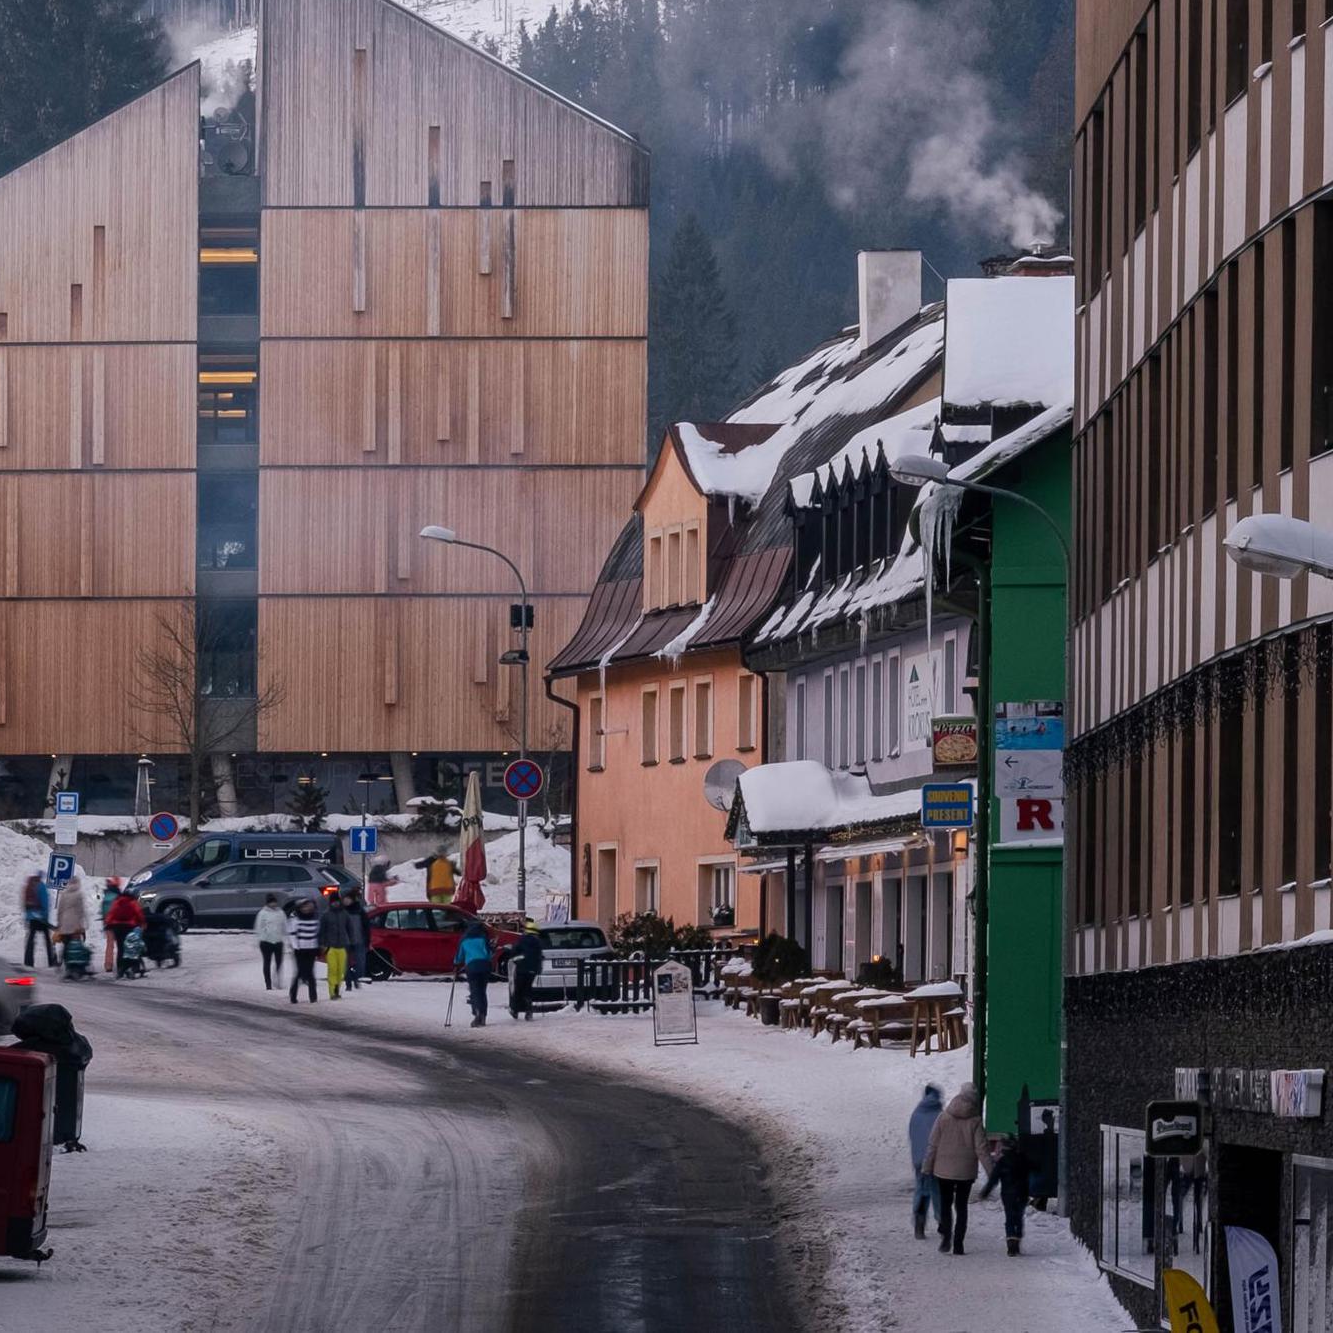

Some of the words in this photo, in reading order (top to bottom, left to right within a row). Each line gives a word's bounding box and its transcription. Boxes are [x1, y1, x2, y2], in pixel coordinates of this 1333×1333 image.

[939, 722, 973, 734] Pizza
[1016, 798, 1055, 831] R
[53, 857, 69, 878] P
